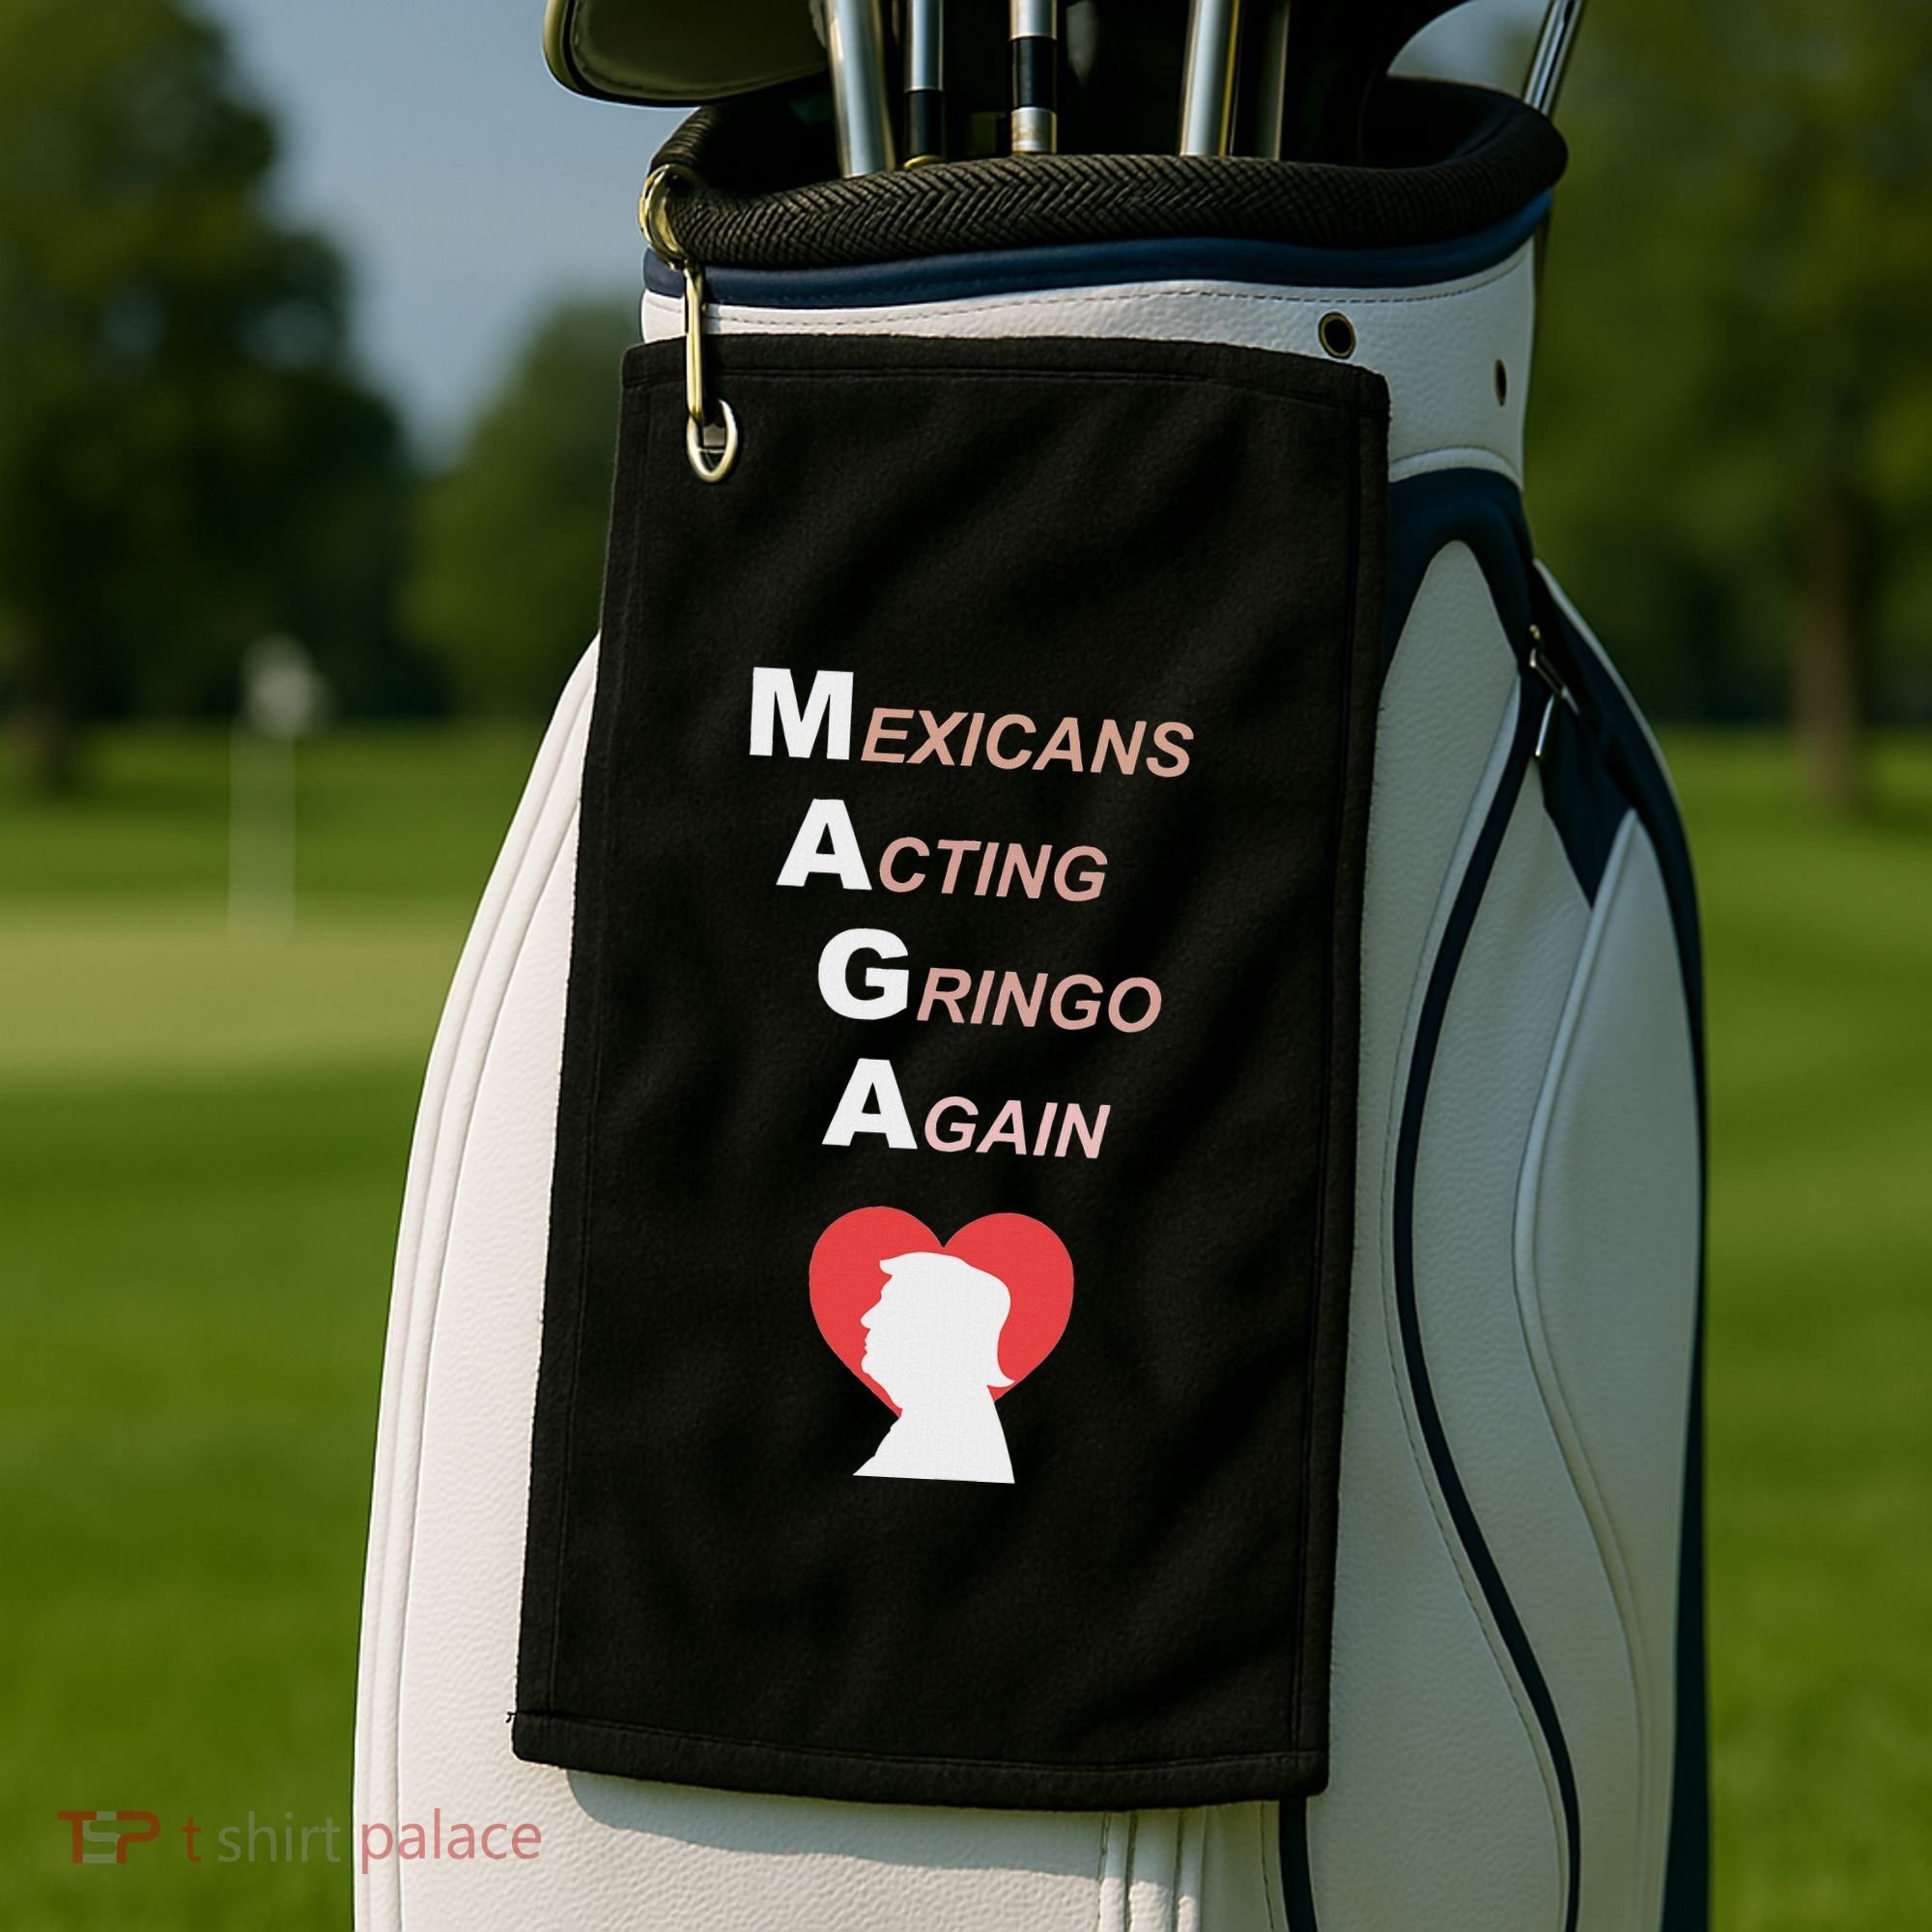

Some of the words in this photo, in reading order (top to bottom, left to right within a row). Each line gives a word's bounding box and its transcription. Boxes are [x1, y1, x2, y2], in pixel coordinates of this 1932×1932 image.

[750, 668, 1194, 778] MEXICANS
[777, 799, 1108, 902] ACTING
[818, 928, 1162, 1033] GRINGO
[822, 1058, 1111, 1159] AGAIN
